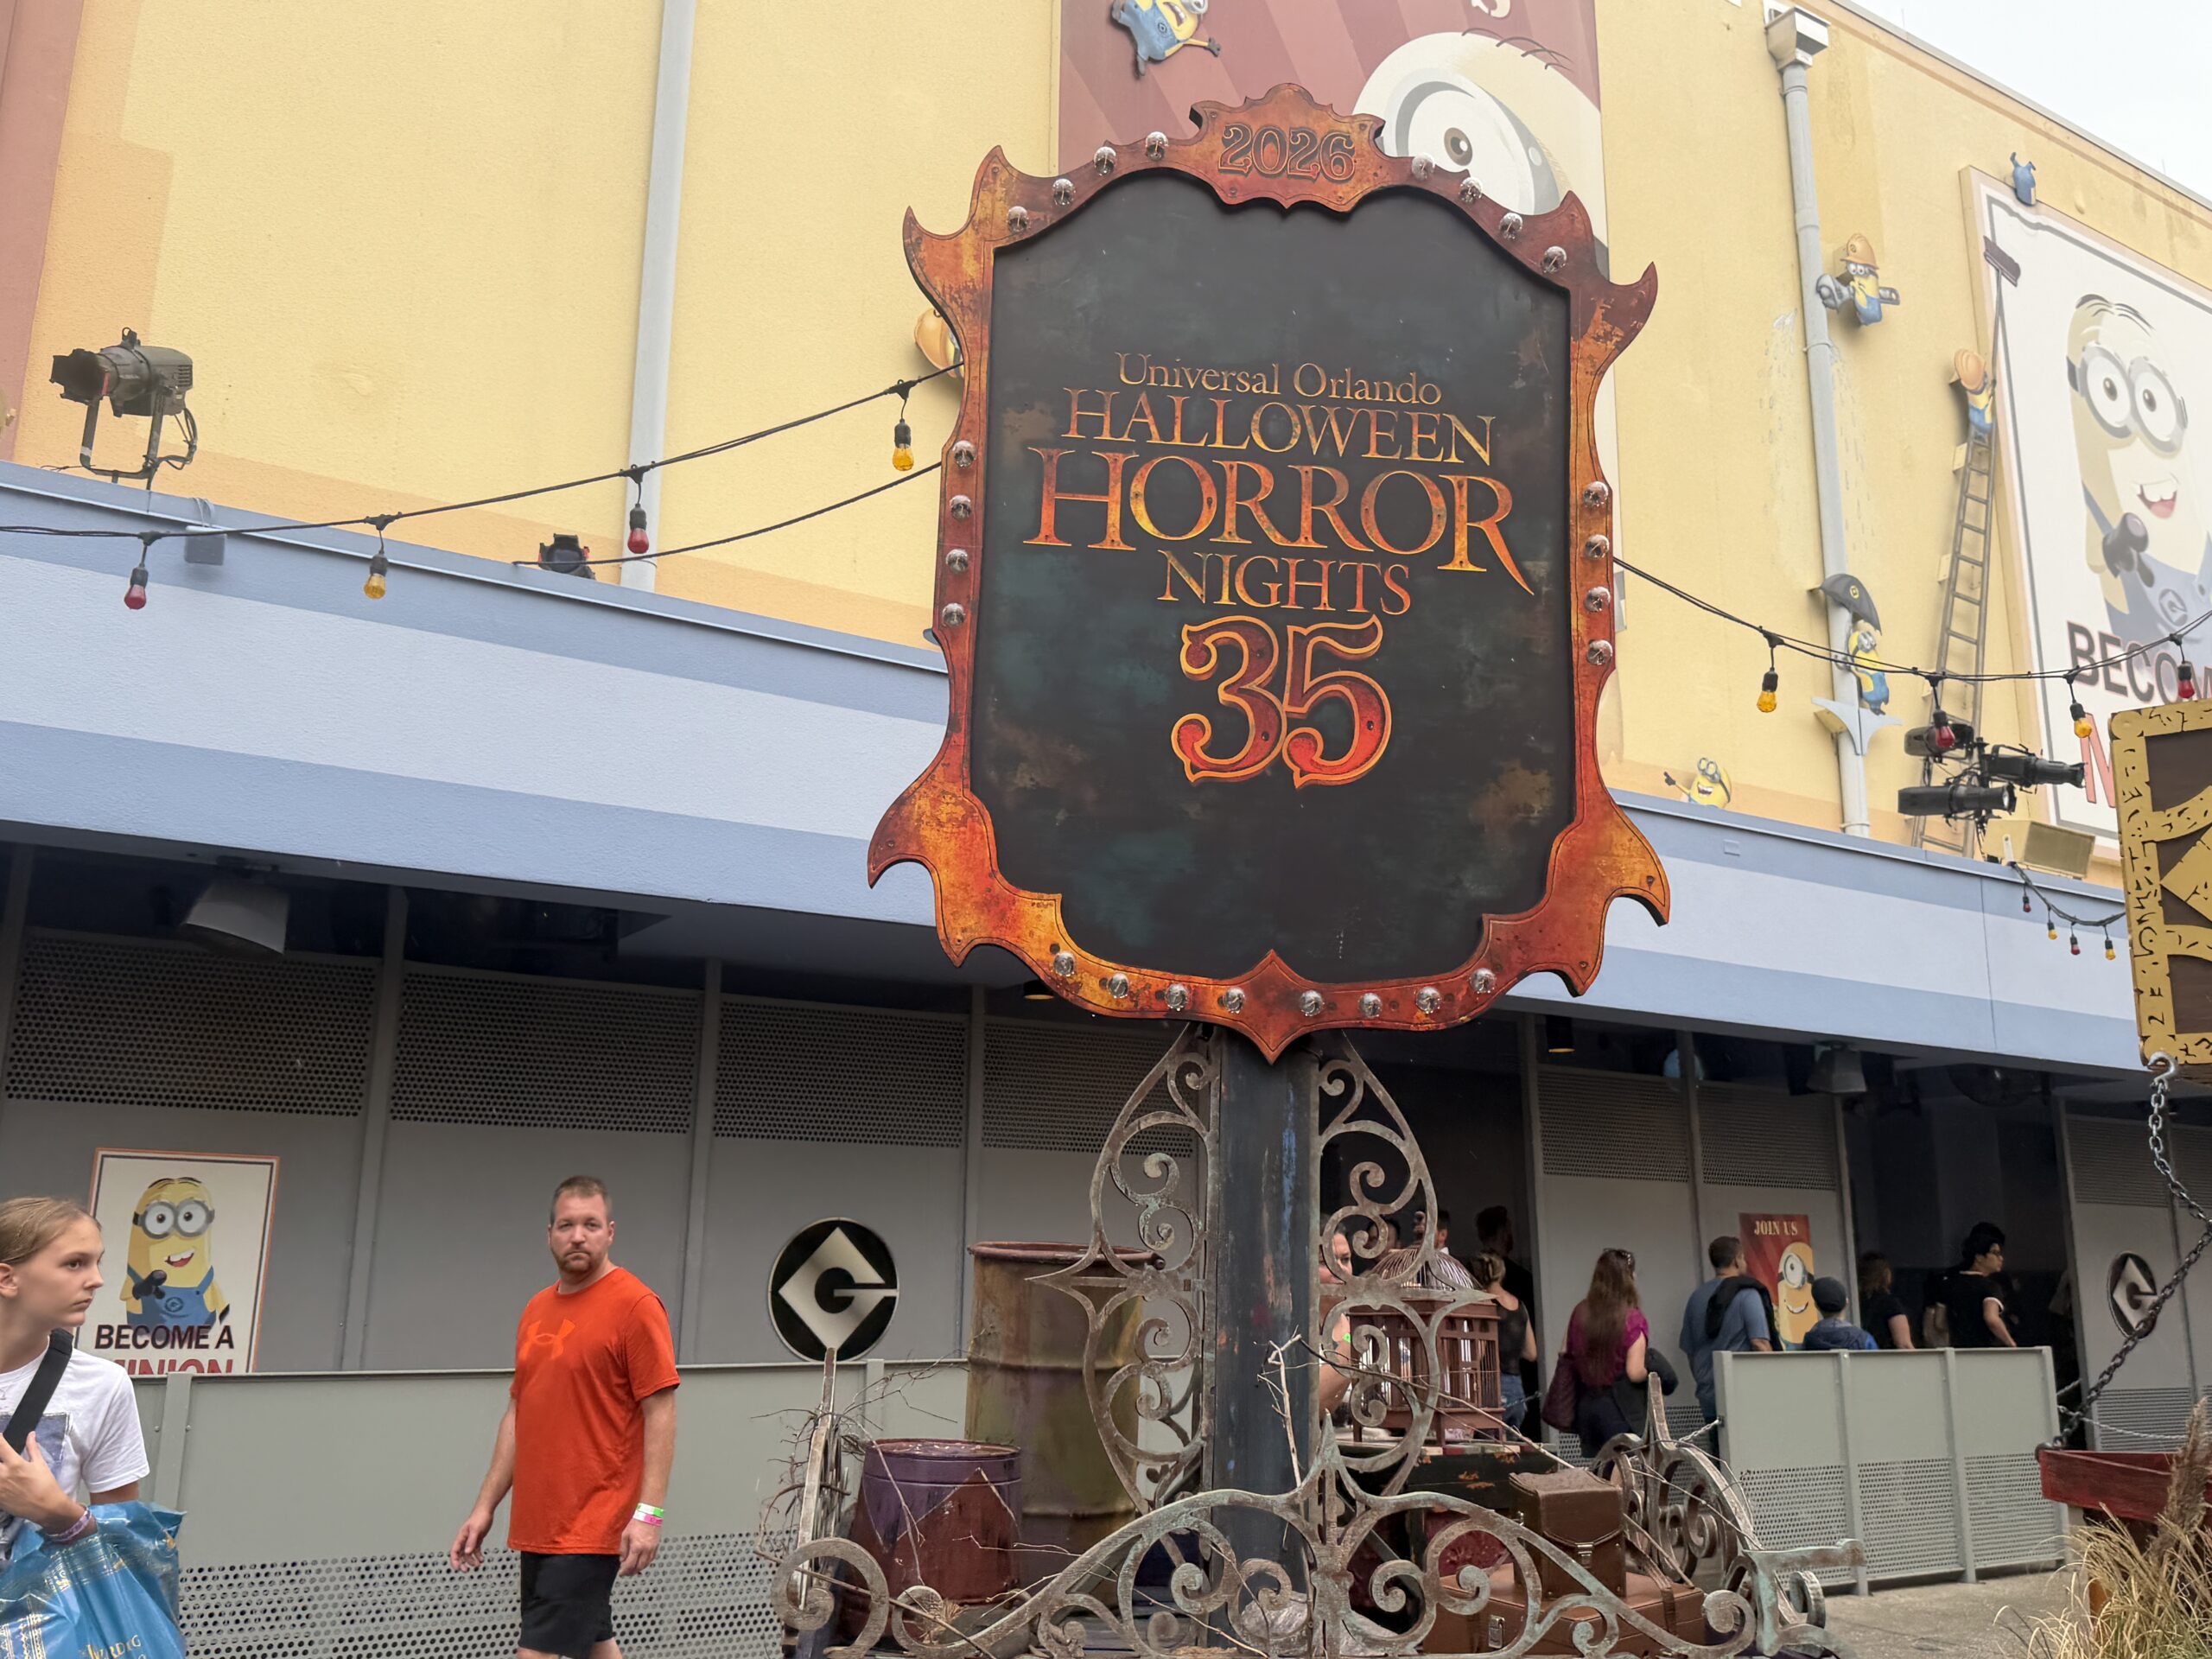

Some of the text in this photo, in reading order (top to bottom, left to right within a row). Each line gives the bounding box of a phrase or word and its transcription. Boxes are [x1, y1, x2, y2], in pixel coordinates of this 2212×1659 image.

[1217, 124, 1356, 182] 2026
[1115, 352, 1442, 406] Universal Orlando
[1060, 387, 1496, 467] HALLOWEEN
[1022, 447, 1535, 596] HORROR
[1156, 550, 1412, 616] NIGHTS
[1171, 613, 1392, 789] 35
[1754, 1220, 1798, 1236] JOIN US
[94, 1324, 235, 1350] BECOME A
